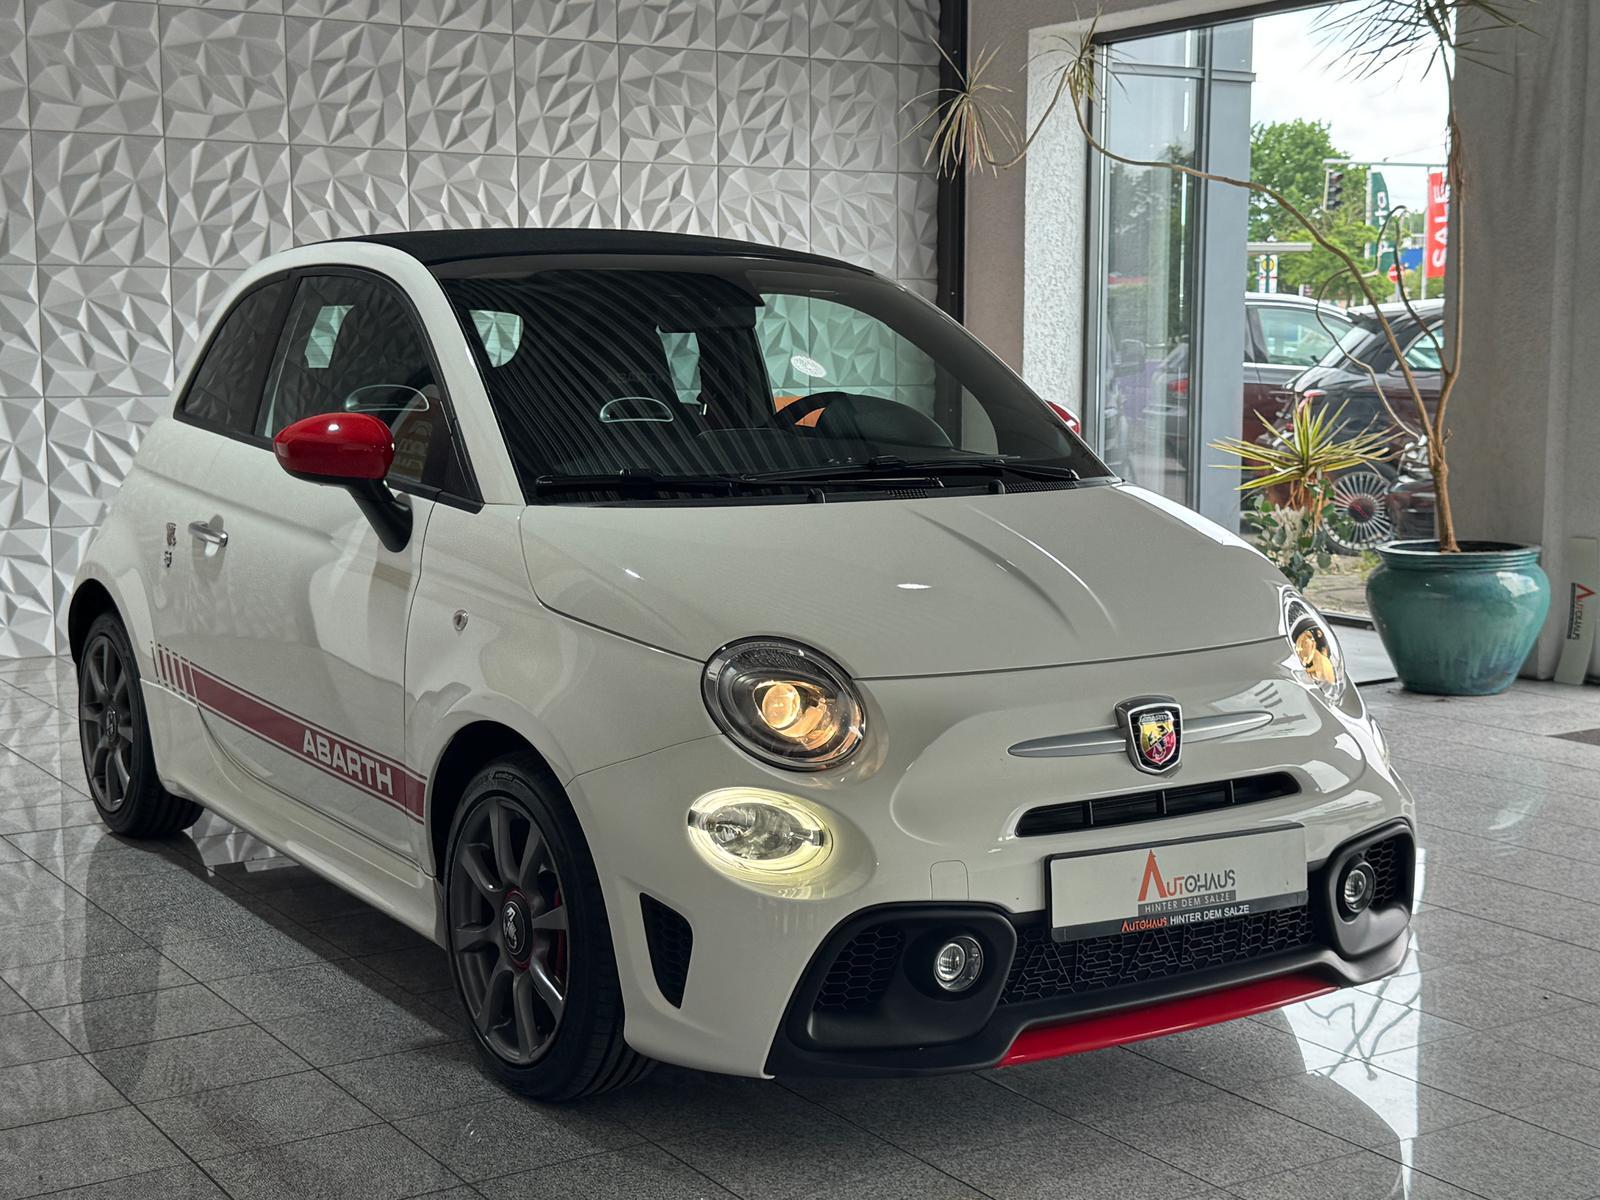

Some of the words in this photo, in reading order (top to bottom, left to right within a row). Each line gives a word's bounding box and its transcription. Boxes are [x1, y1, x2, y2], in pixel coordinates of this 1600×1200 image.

[1432, 184, 1450, 268] SALE
[303, 729, 393, 796] ABARTH
[1138, 849, 1236, 901] AUTOHAUS
[1121, 918, 1168, 932] AUTOHAUS
[1170, 912, 1202, 925] HINTER
[1203, 909, 1222, 920] DEM
[1224, 904, 1250, 916] SALZE
[1144, 901, 1178, 913] HINTER
[1181, 897, 1201, 907] DEM
[1204, 892, 1231, 904] SALZE
